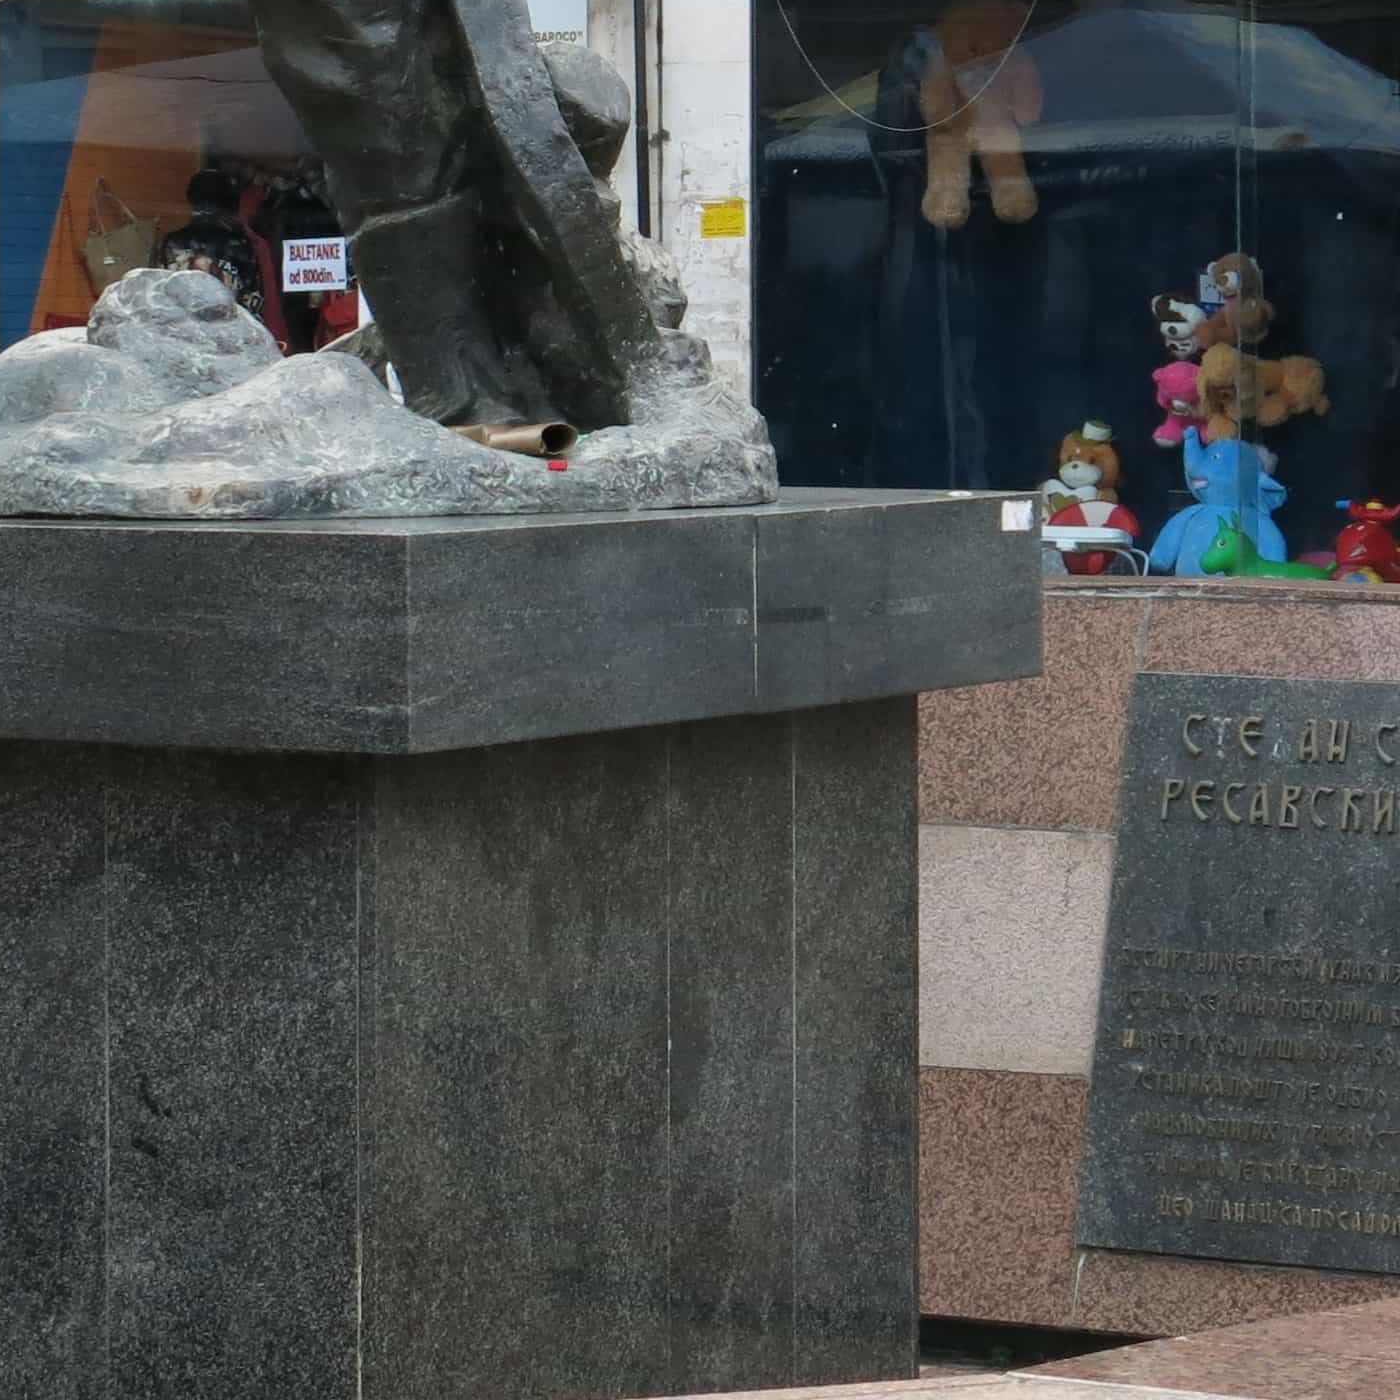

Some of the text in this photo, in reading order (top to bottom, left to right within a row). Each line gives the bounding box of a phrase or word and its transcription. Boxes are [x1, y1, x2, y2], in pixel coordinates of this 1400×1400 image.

[289, 243, 341, 261] BALETANKE
[289, 268, 301, 284] od
[1160, 778, 1396, 835] РЕСАВСКИ
